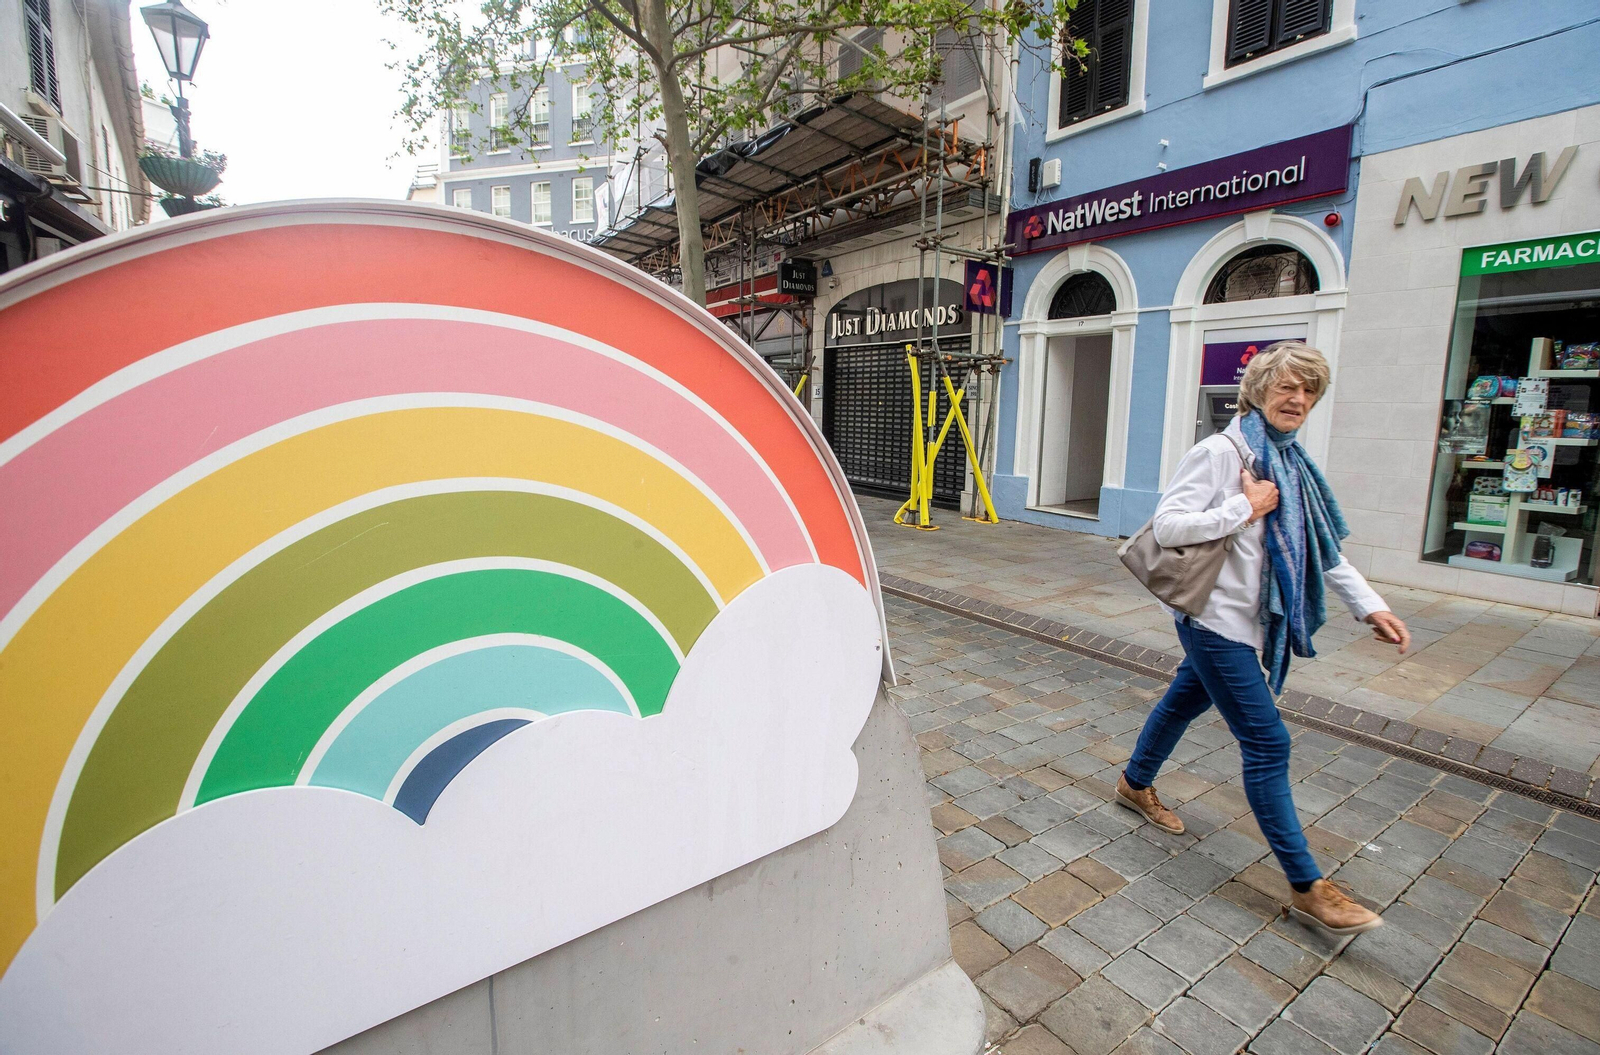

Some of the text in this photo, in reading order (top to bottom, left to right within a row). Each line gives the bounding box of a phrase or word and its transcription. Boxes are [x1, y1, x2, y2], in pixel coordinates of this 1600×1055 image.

[1047, 155, 1306, 235] NatWest International
[1394, 145, 1579, 226] NEW
[782, 279, 815, 292] DIAMONDS
[792, 270, 806, 280] JUST
[831, 304, 958, 340] JUST DIAMONDS
[814, 388, 821, 396] 15
